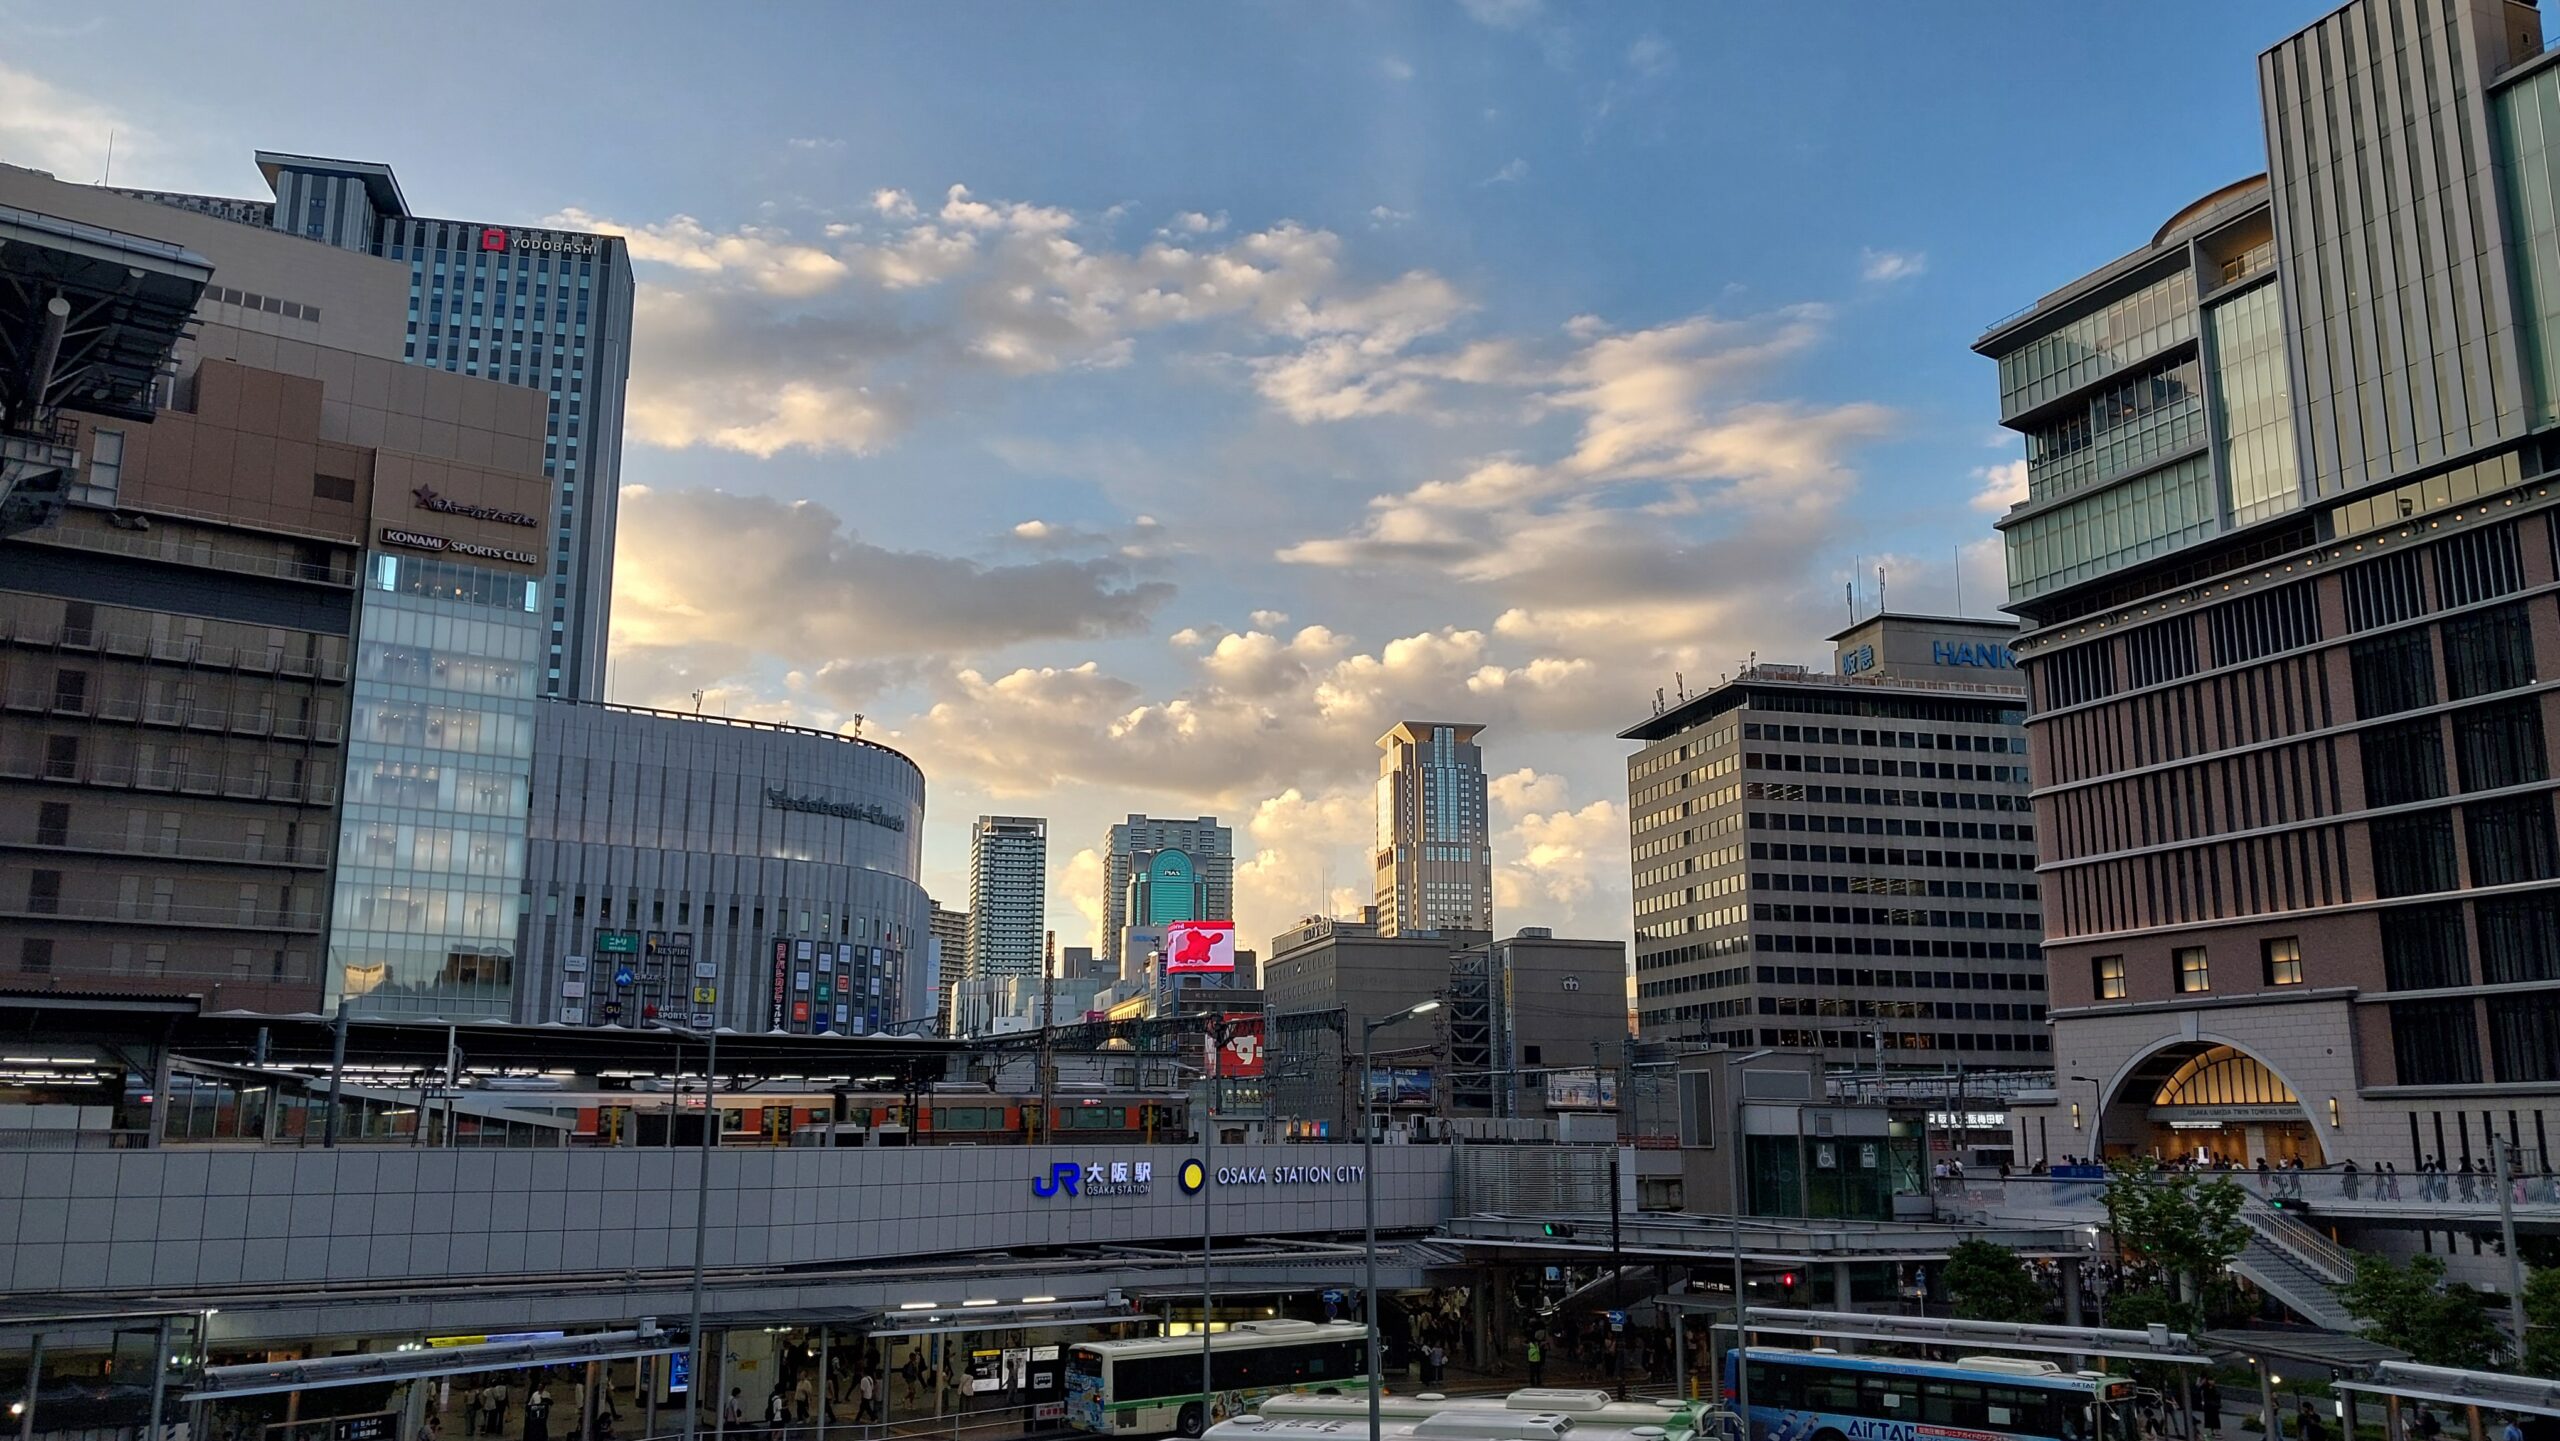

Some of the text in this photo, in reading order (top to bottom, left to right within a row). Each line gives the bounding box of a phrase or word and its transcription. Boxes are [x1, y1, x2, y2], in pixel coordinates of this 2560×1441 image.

[511, 238, 598, 255] YODOBASHI
[387, 530, 538, 564] KONAMI SPORTS CLUB
[1843, 644, 1873, 676] 阪急
[657, 1012, 688, 1020] SPORTS
[1034, 1163, 1081, 1197] JR
[1086, 1162, 1150, 1183] 大阪駅
[1218, 1166, 1365, 1185] OSAKA STATION CITY
[1117, 1184, 1150, 1194] STATION
[339, 1425, 346, 1439] 1
[1847, 1419, 1914, 1441] AirTAC
